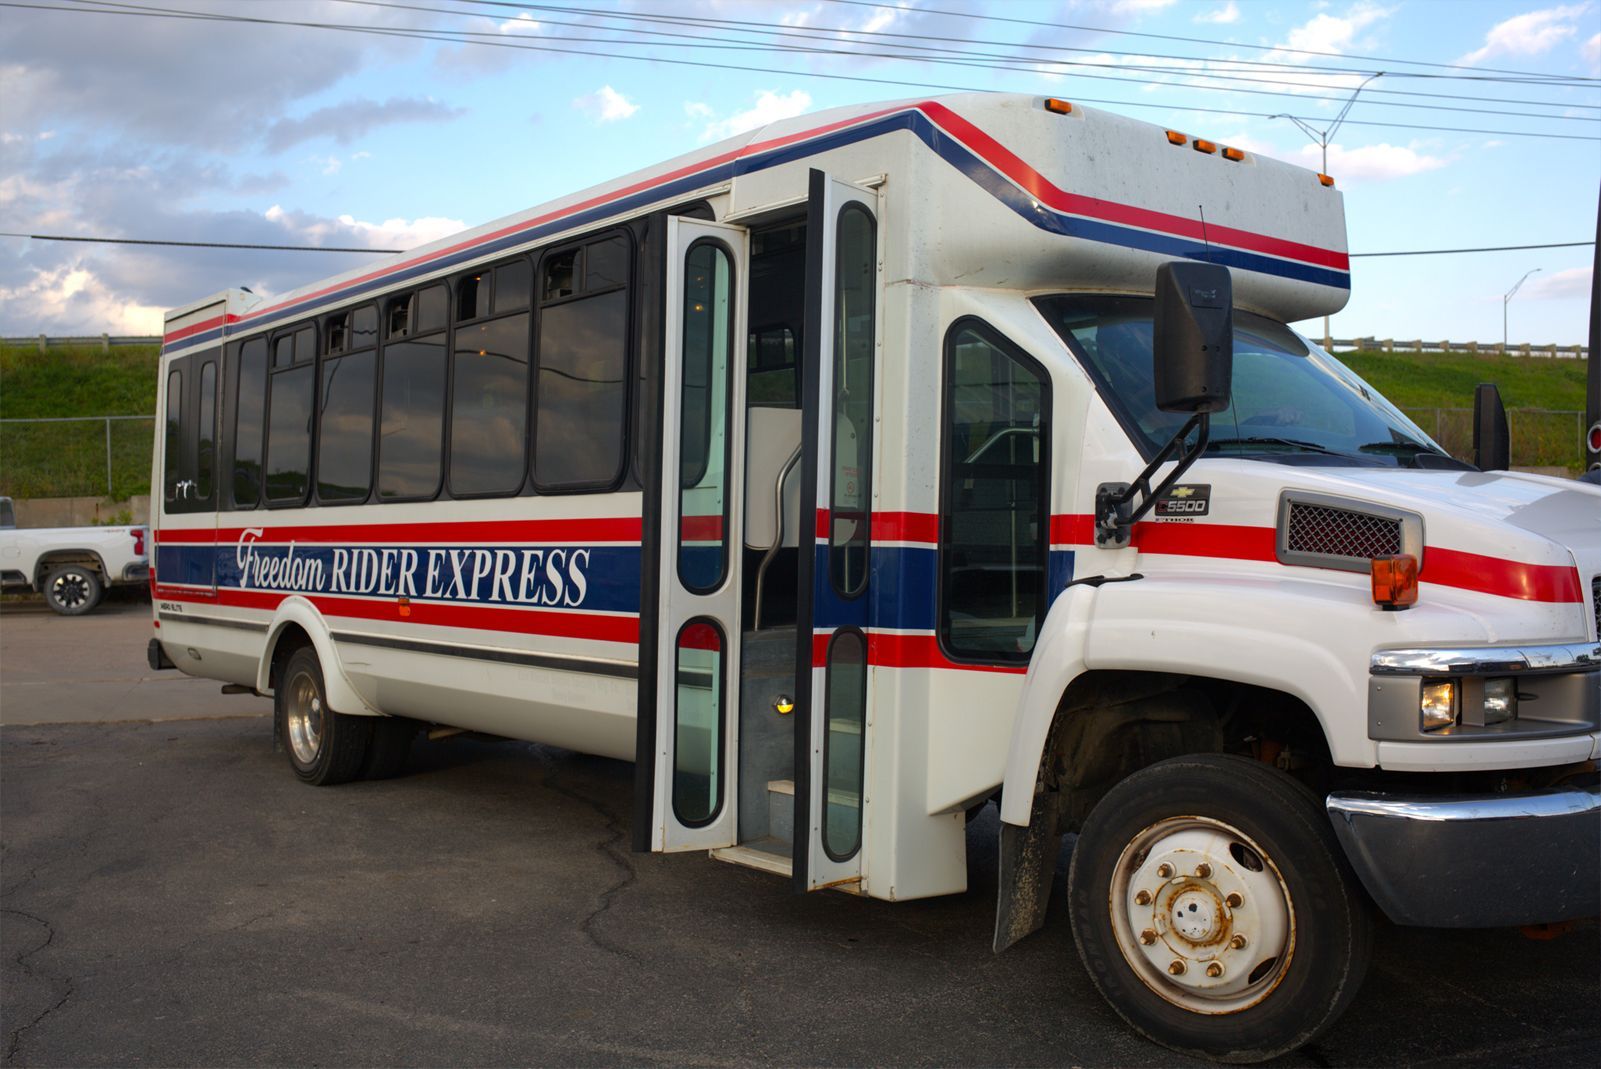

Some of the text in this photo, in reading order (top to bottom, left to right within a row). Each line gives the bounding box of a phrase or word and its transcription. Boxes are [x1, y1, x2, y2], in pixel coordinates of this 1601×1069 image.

[236, 528, 591, 607] Freedom RIDER EXPRESS
